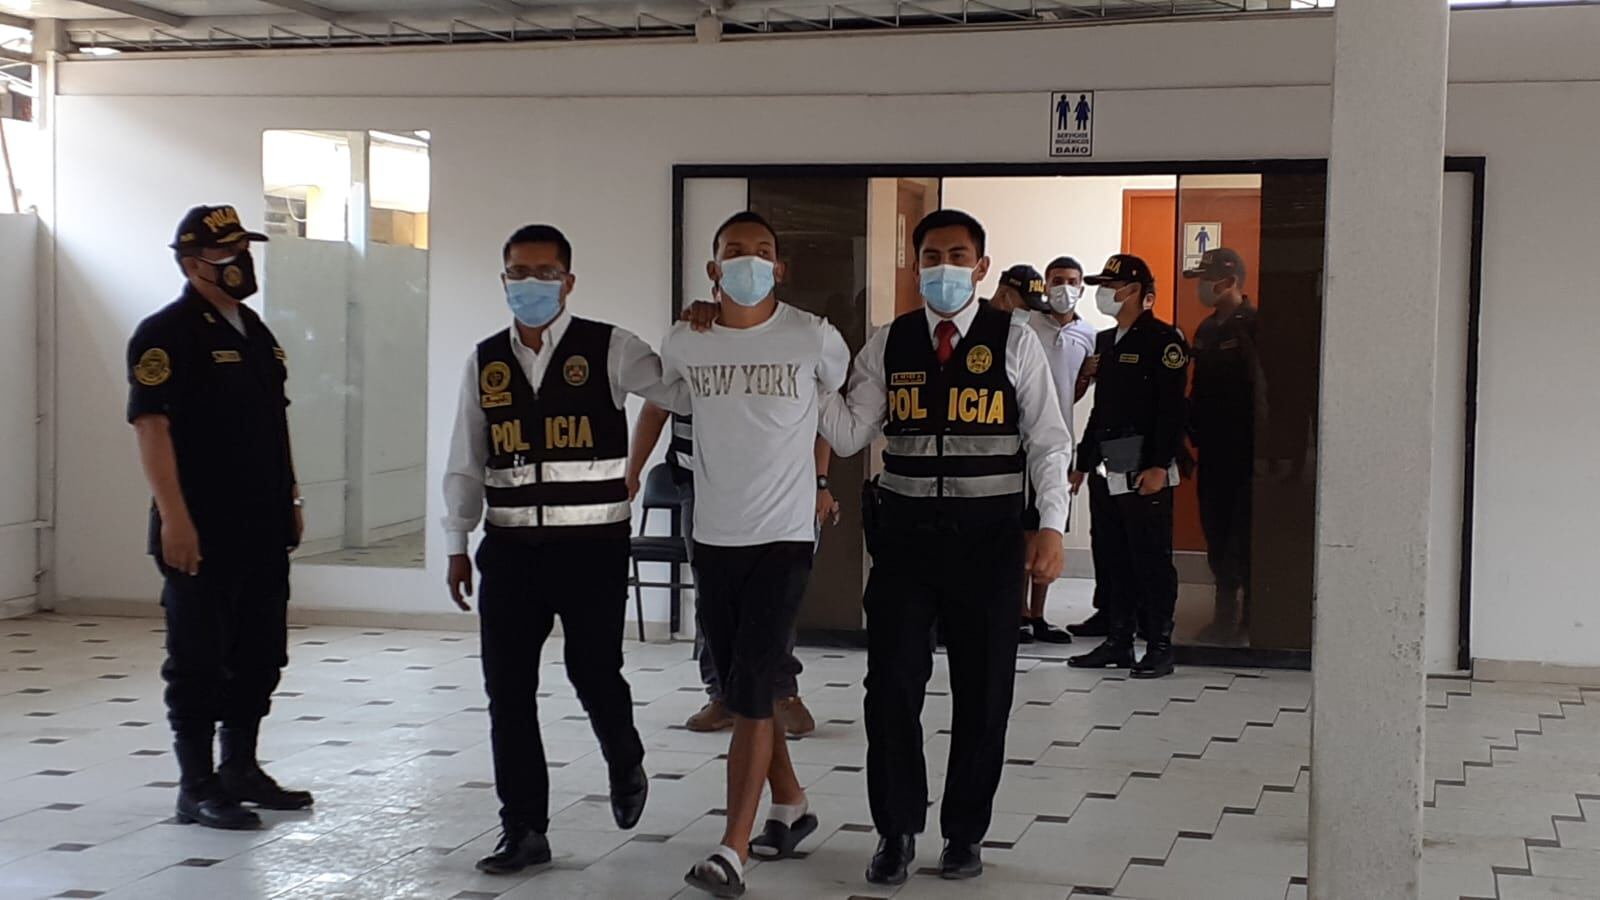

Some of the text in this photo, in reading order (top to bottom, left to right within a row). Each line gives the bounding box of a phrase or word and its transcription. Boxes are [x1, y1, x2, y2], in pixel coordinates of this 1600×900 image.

[687, 363, 800, 398] NEW YORK
[491, 419, 530, 455] POL
